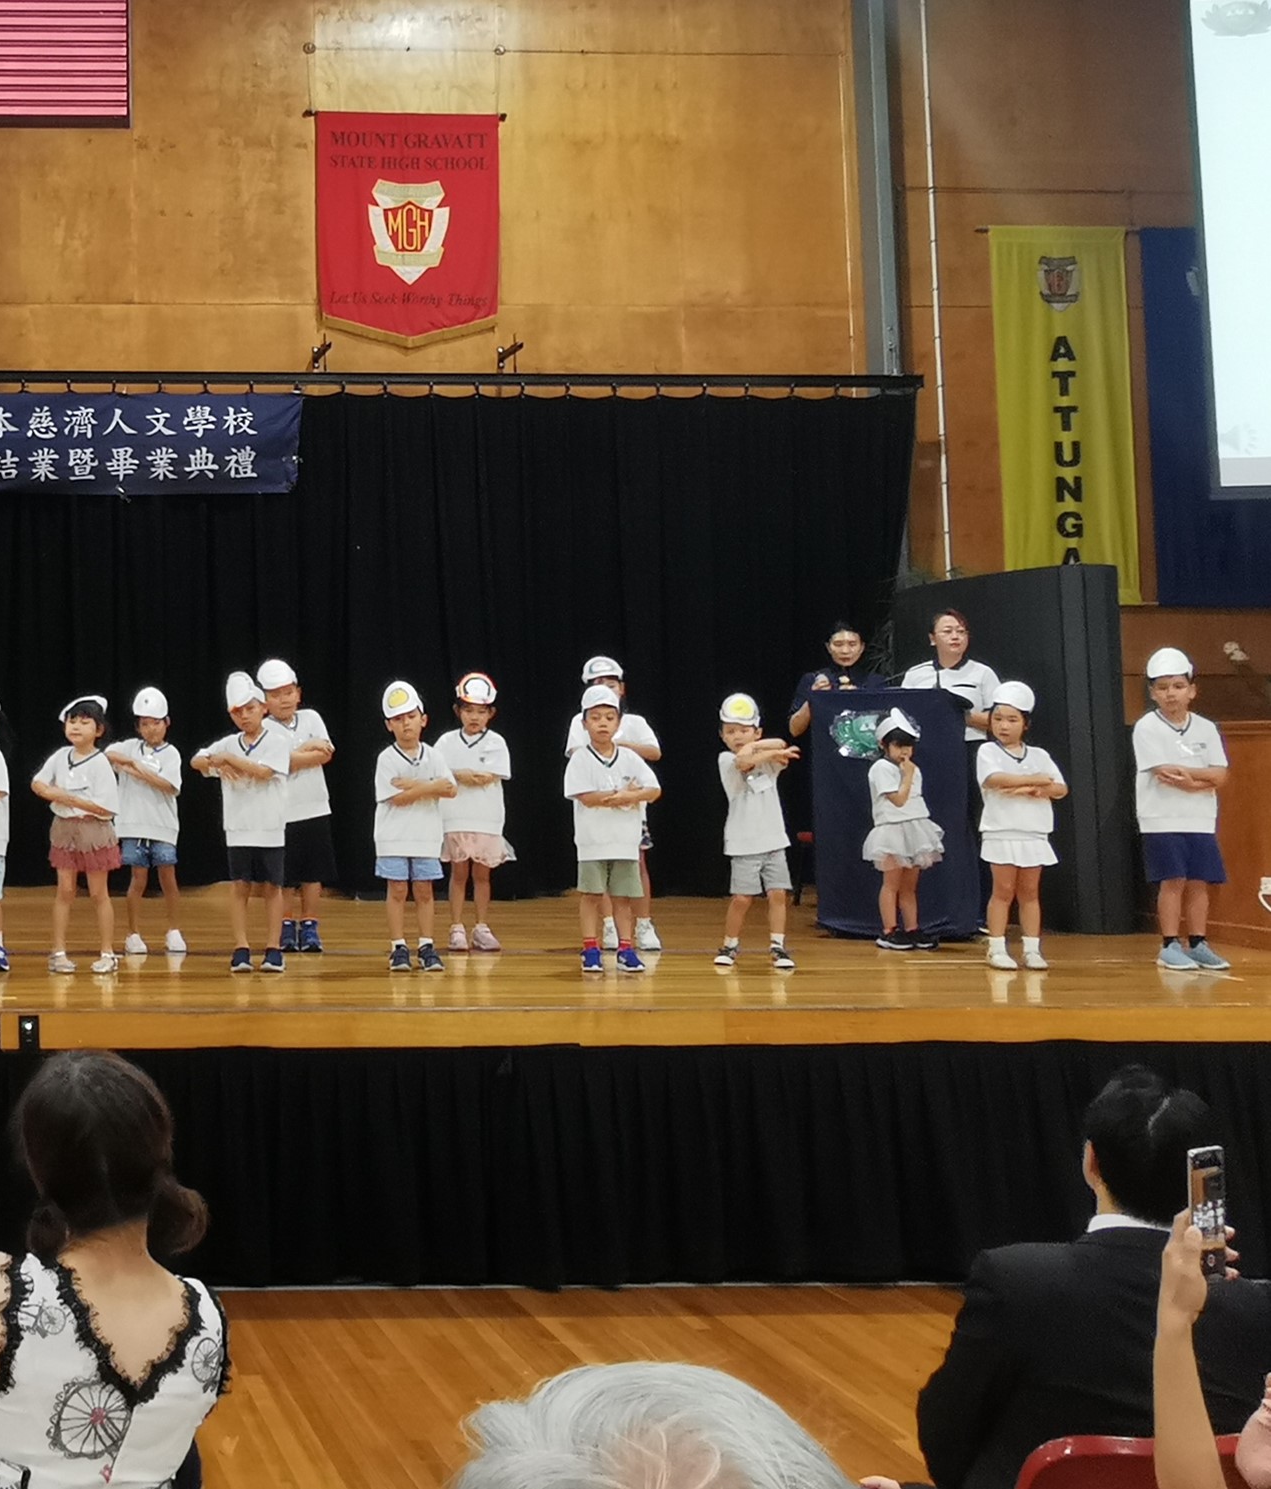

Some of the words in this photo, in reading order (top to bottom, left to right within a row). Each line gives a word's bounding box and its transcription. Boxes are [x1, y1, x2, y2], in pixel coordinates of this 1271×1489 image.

[330, 131, 398, 148] MOUNT
[404, 133, 488, 149] GRAVATT
[330, 155, 377, 169] STATE
[382, 156, 420, 170] HIGH
[424, 157, 489, 171] SCHOOL
[388, 204, 430, 251] MGH
[329, 291, 350, 305] Let
[352, 292, 367, 305] Us
[370, 292, 397, 305] Seek
[401, 292, 443, 308] Worthy
[448, 293, 488, 310] Things
